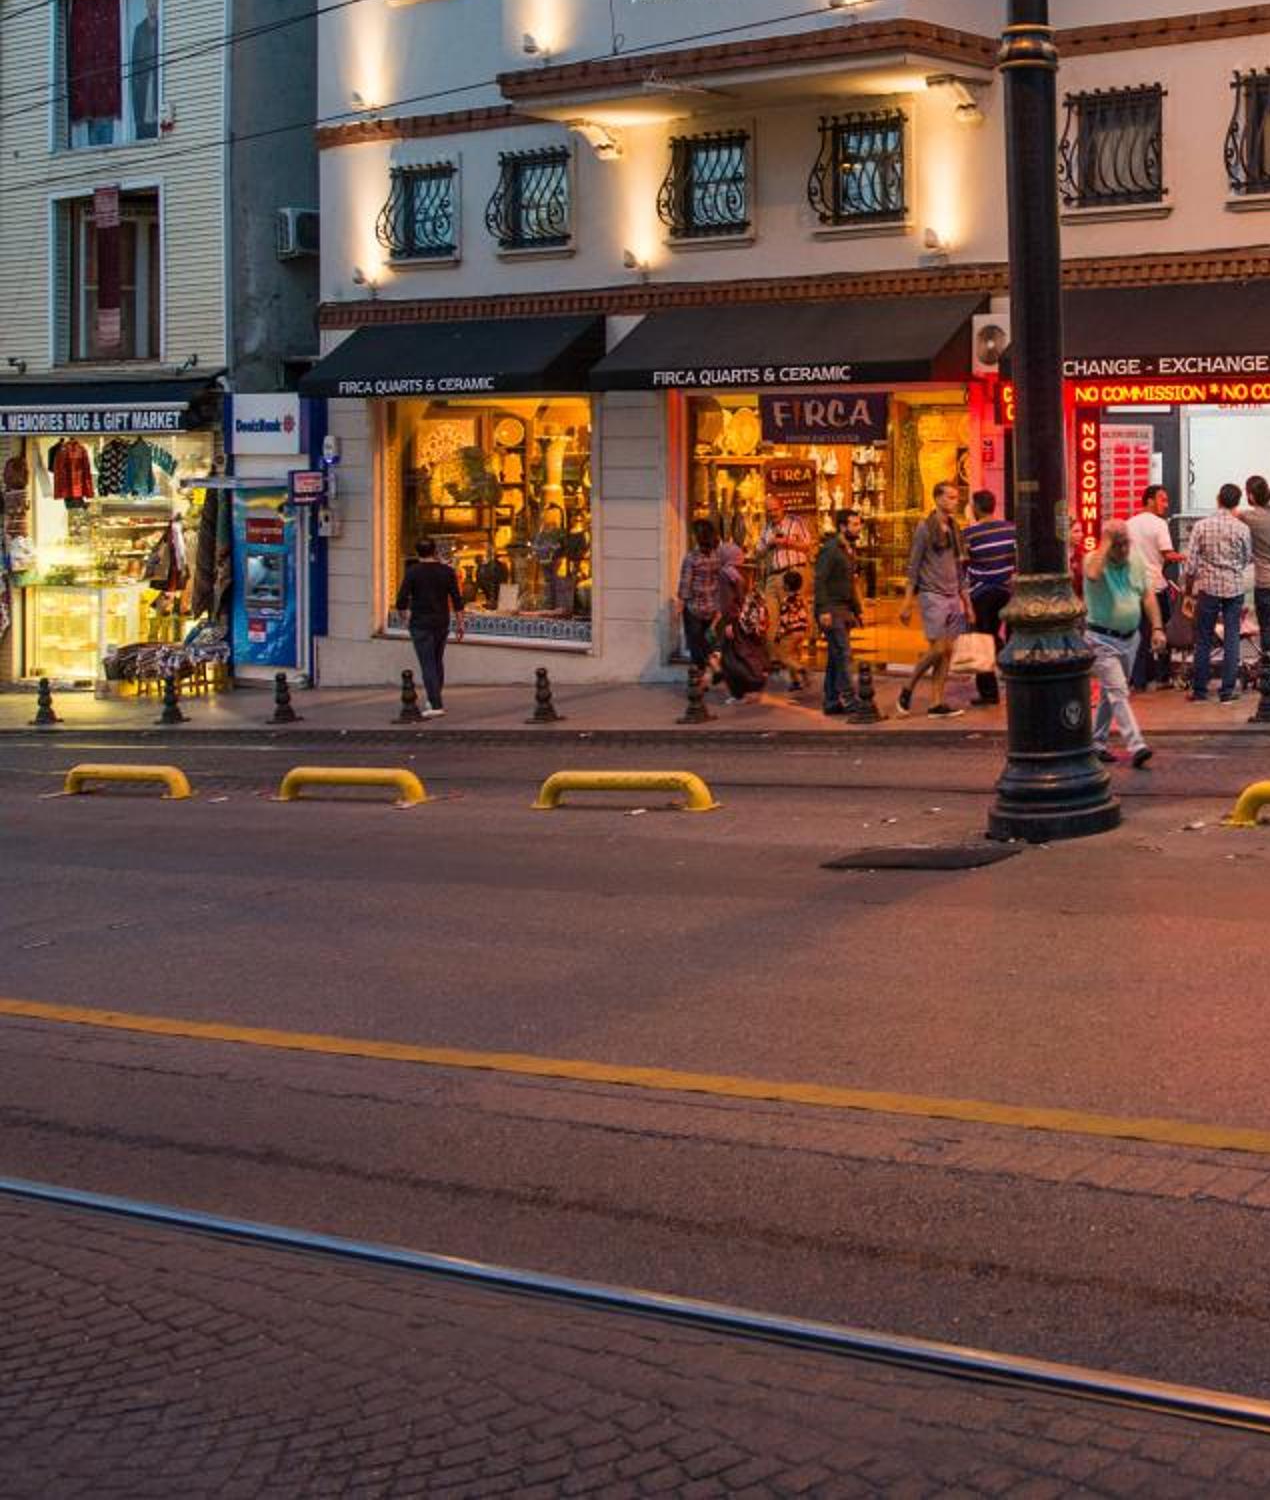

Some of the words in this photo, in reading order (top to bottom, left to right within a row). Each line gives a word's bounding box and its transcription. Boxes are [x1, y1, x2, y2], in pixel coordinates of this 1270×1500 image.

[1159, 355, 1270, 374] EXCHANGE
[338, 381, 372, 394] FIRCA
[375, 378, 423, 394] QUARTS
[425, 379, 436, 391] &
[438, 376, 495, 391] CERAMIC
[653, 370, 696, 386] FIRCA
[700, 367, 759, 385] QUARTS
[763, 367, 775, 382] &
[779, 365, 851, 382] CERAMIC
[1075, 387, 1099, 402] NO
[1101, 384, 1207, 402] COMMISSION
[1221, 383, 1247, 400] NO
[7, 413, 64, 431] MEMORIES
[66, 413, 90, 431] RUG
[92, 413, 101, 430] &
[103, 412, 130, 430] GIFT
[131, 410, 182, 430] MARKET
[1082, 422, 1097, 451] NO
